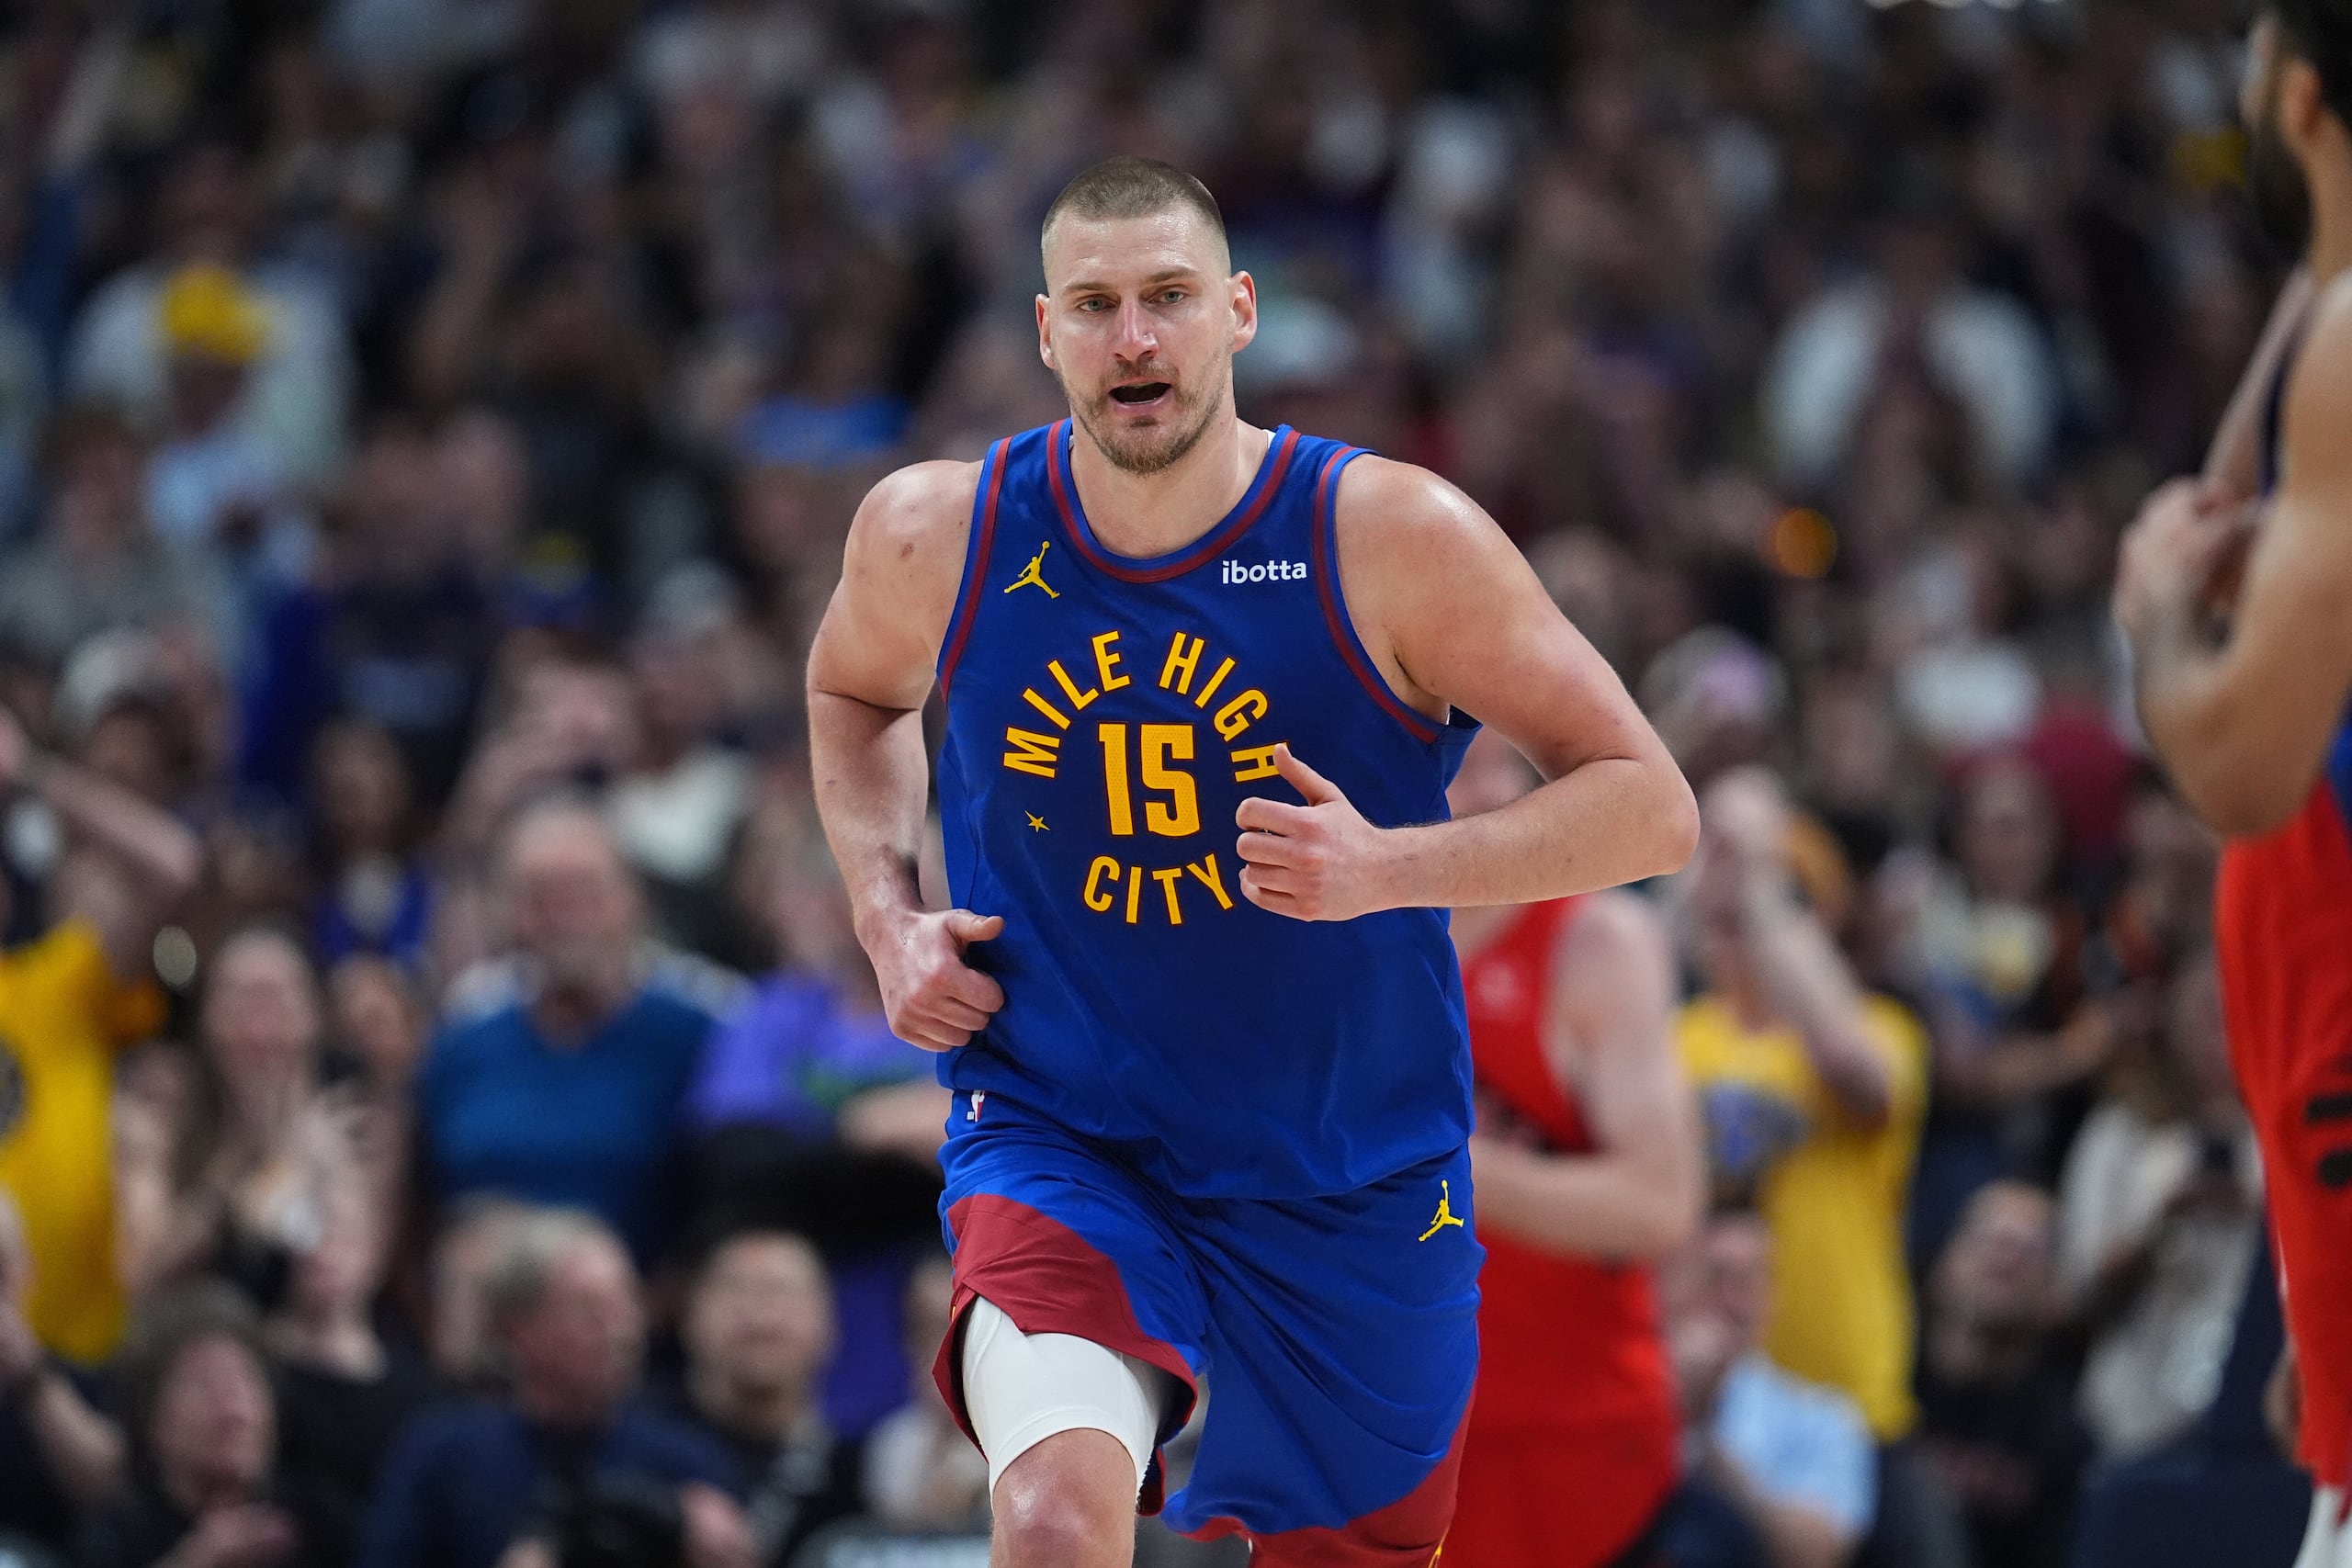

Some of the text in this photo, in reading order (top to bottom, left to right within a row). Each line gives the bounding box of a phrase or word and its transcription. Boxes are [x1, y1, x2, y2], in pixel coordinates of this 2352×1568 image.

[1221, 559, 1308, 585] ibotta
[1002, 630, 1288, 783] MILE HIGH
[1098, 722, 1201, 837] 15
[1083, 852, 1234, 926] CITY
